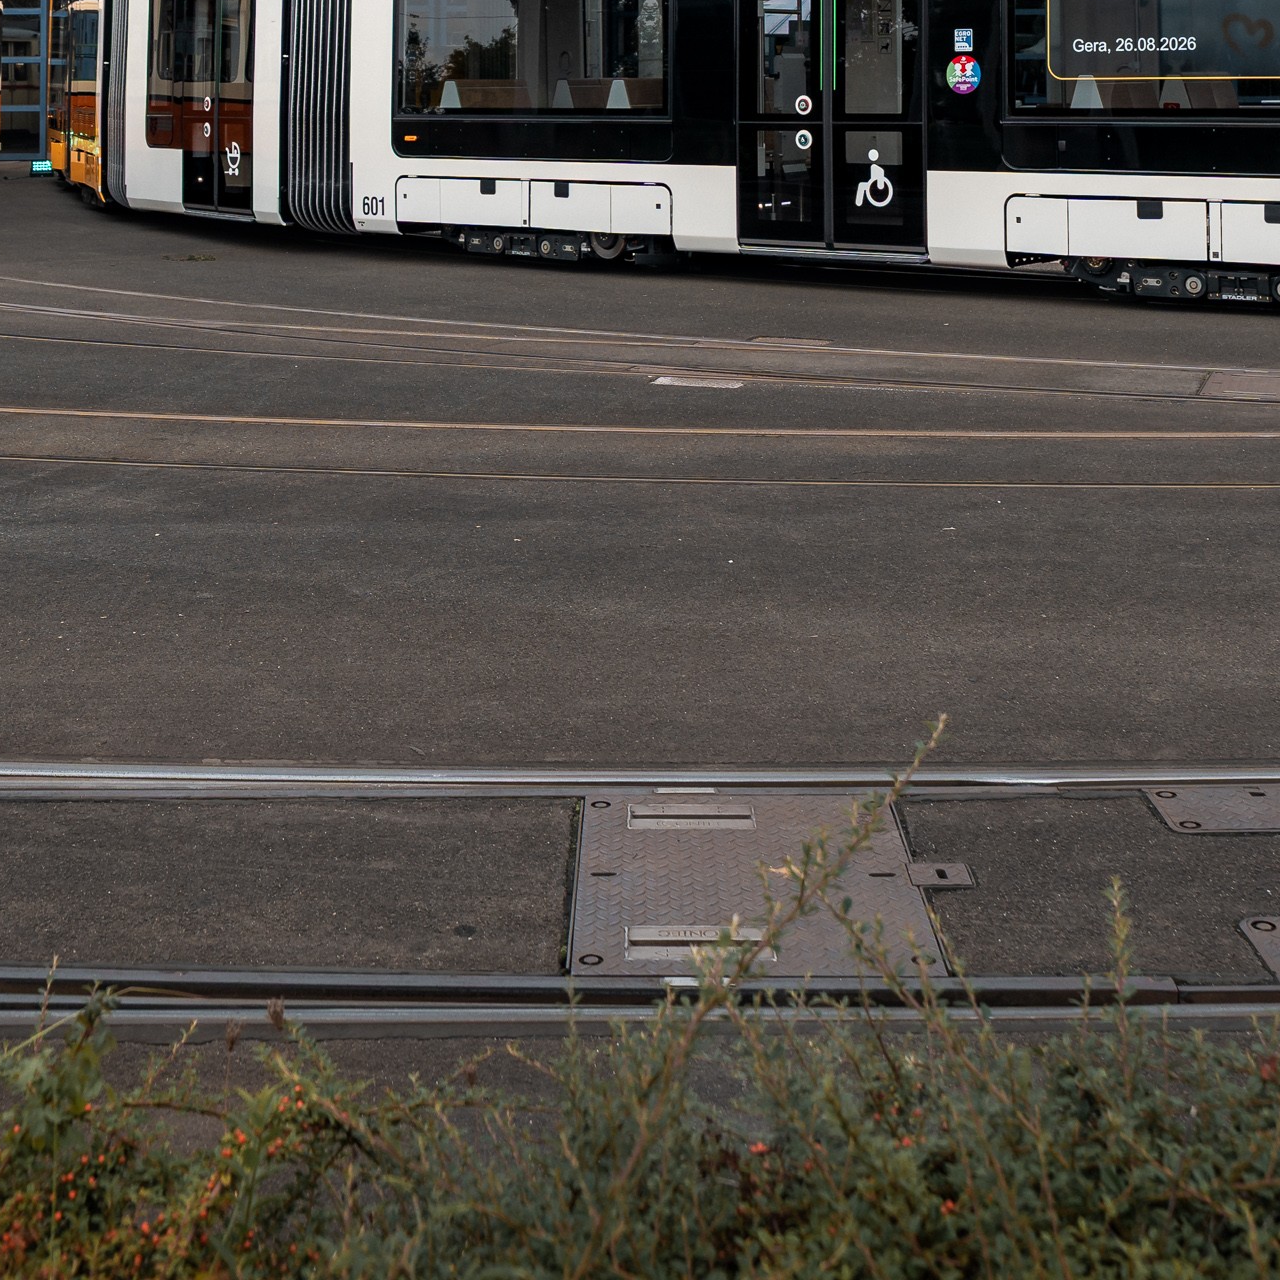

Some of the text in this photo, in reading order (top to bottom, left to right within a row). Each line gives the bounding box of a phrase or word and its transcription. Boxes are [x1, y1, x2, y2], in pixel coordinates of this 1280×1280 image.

[1072, 36, 1197, 54] Gera, 26.08.2026
[362, 196, 385, 216] 601
